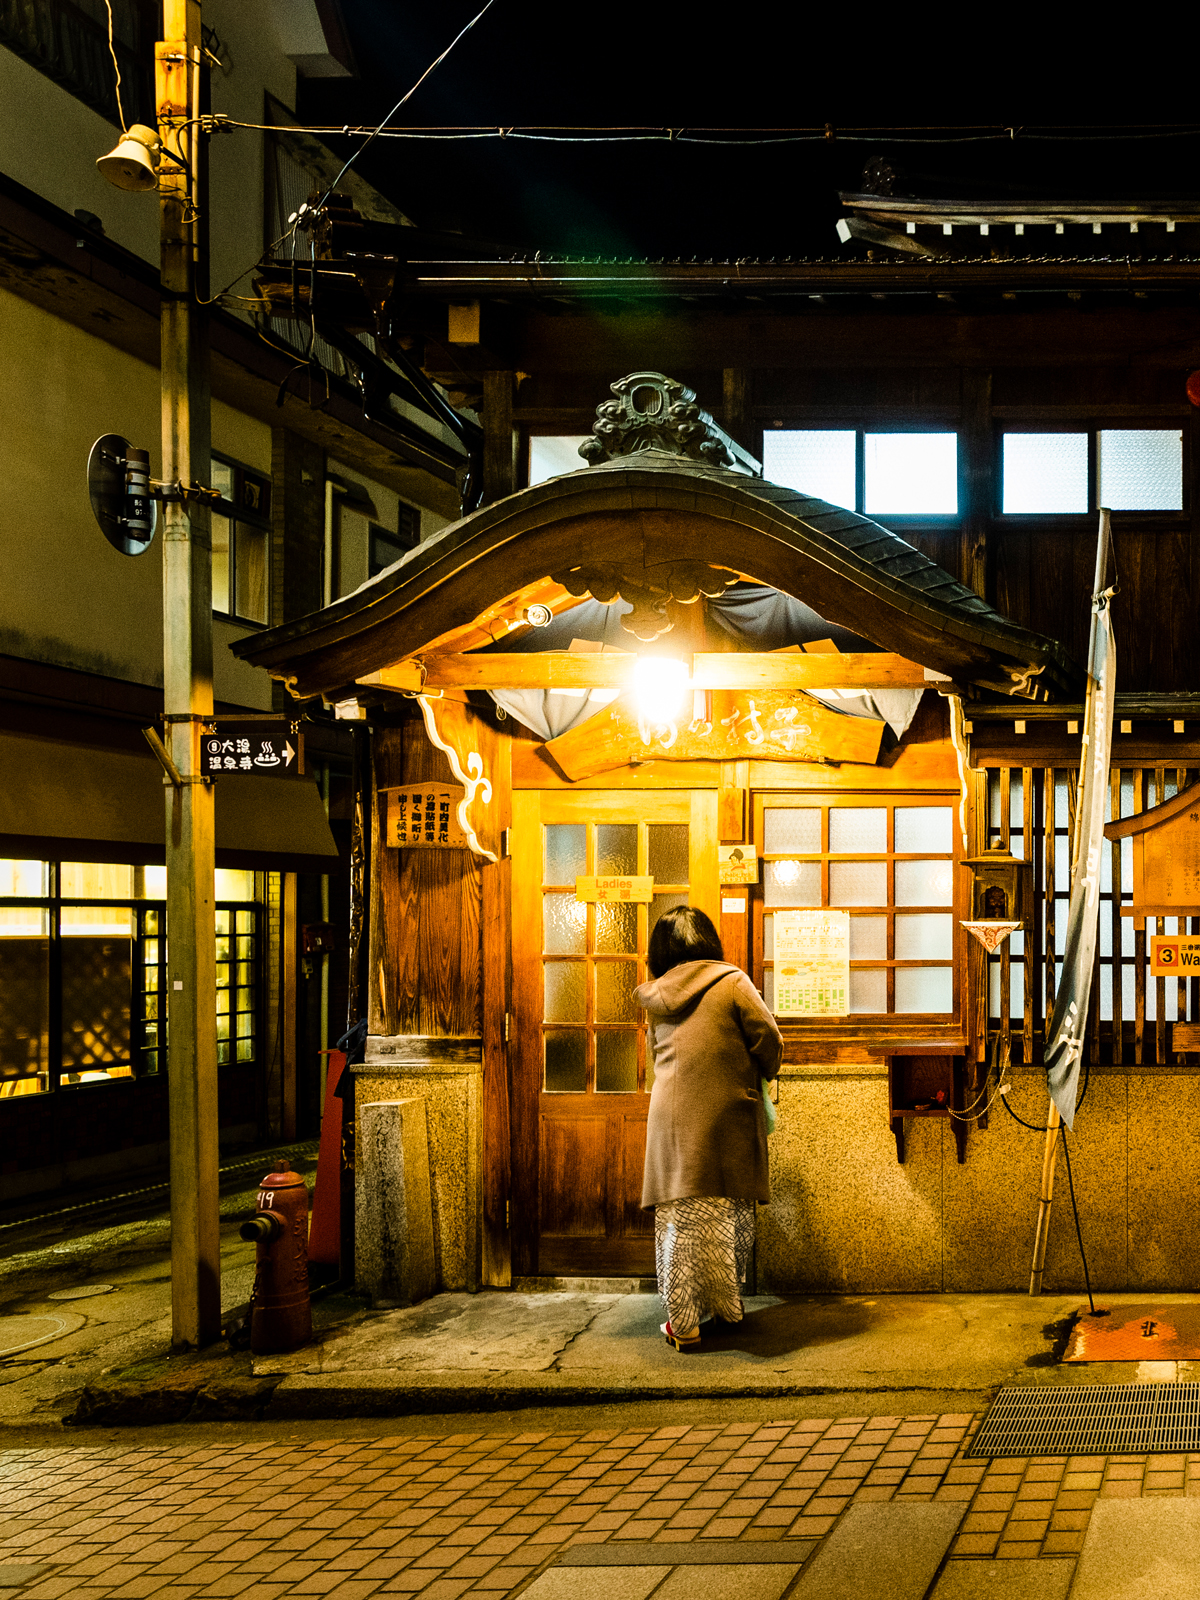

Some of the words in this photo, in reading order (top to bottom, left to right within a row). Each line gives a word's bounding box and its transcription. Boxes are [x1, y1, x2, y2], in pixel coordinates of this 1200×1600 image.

[208, 755, 253, 770] 温泉寺
[595, 879, 632, 888] Ladies
[1162, 949, 1173, 962] 3
